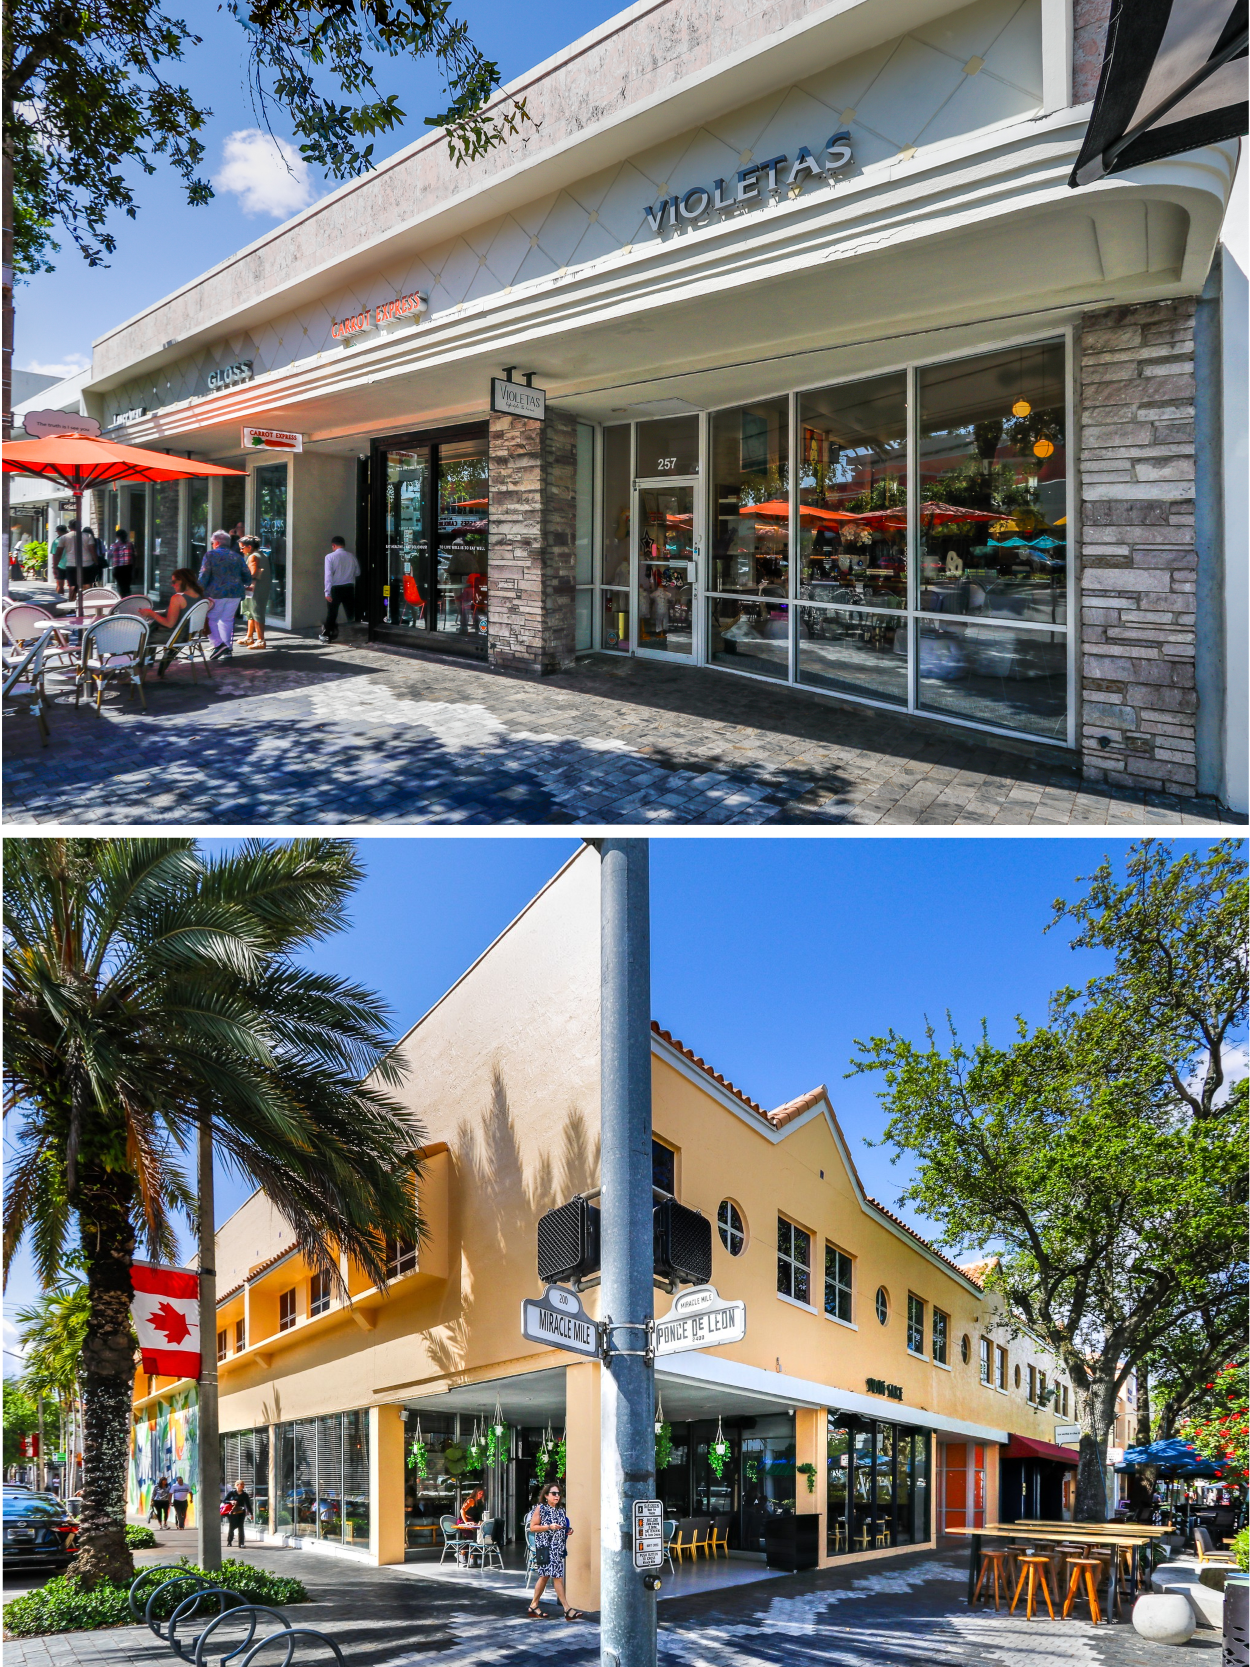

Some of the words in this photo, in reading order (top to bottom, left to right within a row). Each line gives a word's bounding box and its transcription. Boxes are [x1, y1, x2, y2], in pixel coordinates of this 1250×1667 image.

[642, 130, 853, 234] VIOLETAS
[331, 309, 371, 339] CARROT
[375, 290, 421, 324] EXPRESS
[207, 360, 254, 389] GLOSS
[500, 383, 541, 409] VIOLETAS
[249, 429, 274, 438] CARROT
[275, 433, 298, 441] EXPRESS
[657, 457, 677, 470] 257
[559, 1293, 569, 1306] 200
[680, 1297, 700, 1310] MIRACLE
[700, 1293, 713, 1303] MILE
[538, 1308, 572, 1340] MIRACLE
[573, 1320, 591, 1345] MILE
[657, 1321, 688, 1345] PONCE
[691, 1316, 705, 1337] DE
[707, 1308, 736, 1334] LEON
